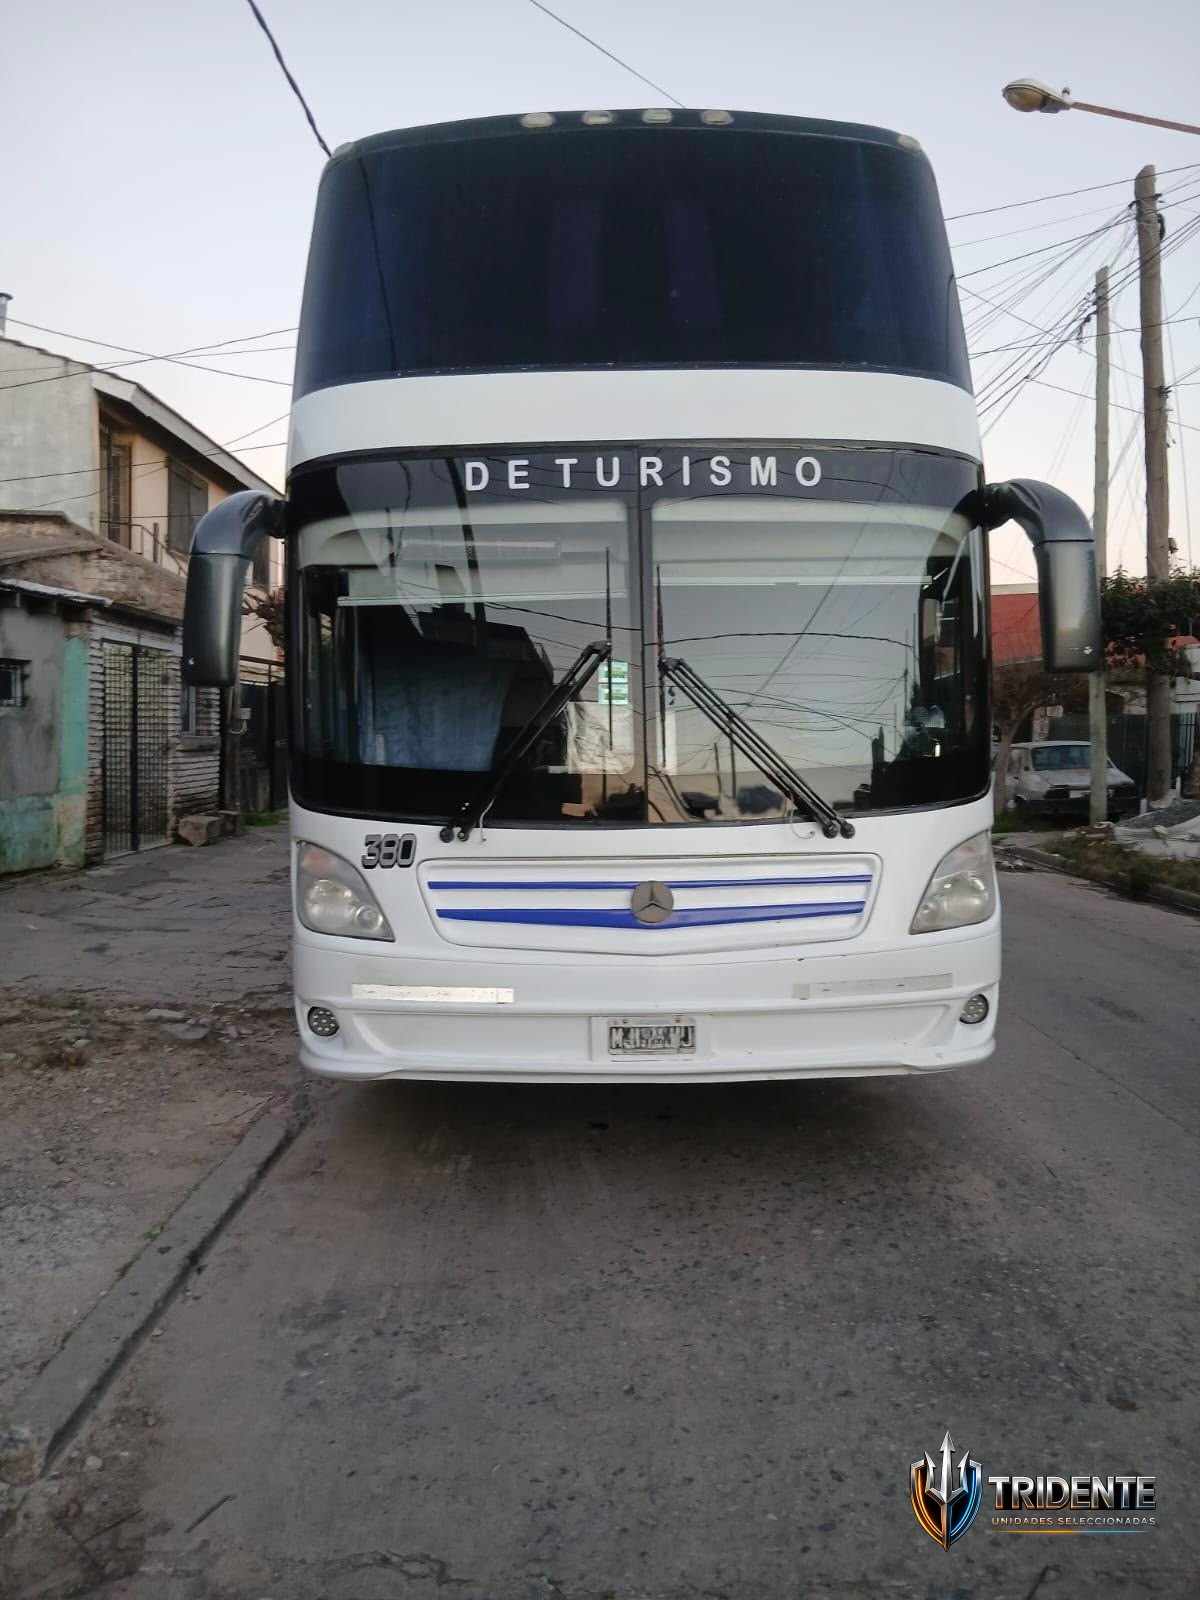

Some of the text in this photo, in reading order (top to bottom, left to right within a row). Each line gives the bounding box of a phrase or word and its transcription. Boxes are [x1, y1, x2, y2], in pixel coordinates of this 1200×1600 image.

[465, 456, 823, 491] DE TURISMO
[362, 833, 417, 869] 380
